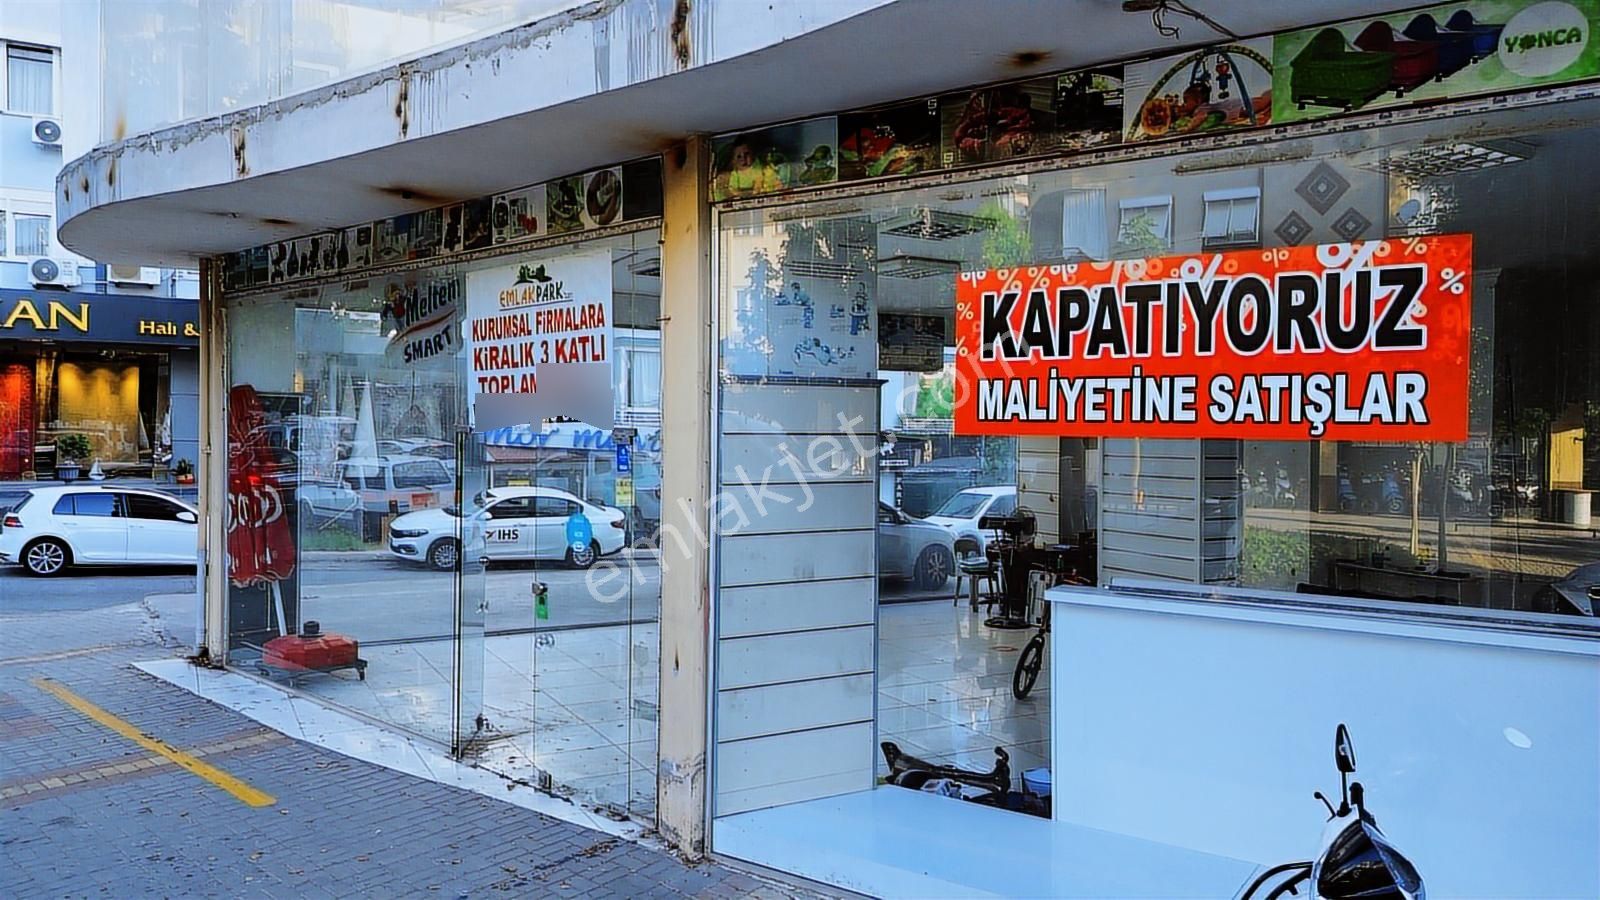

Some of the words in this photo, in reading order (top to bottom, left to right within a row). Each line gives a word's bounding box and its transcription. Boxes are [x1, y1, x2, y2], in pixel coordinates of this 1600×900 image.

[0, 300, 89, 332] AN
[406, 279, 460, 328] Meltem
[981, 263, 1427, 360] KAPATIYORUZ
[404, 325, 451, 363] SMART
[472, 313, 532, 343] KURUMSAL
[540, 341, 549, 363] 3
[555, 335, 605, 363] KATLI
[978, 365, 1199, 423] MALİYETİNE
[1208, 372, 1429, 435] SATIŞLAR
[497, 529, 519, 541] IHS
